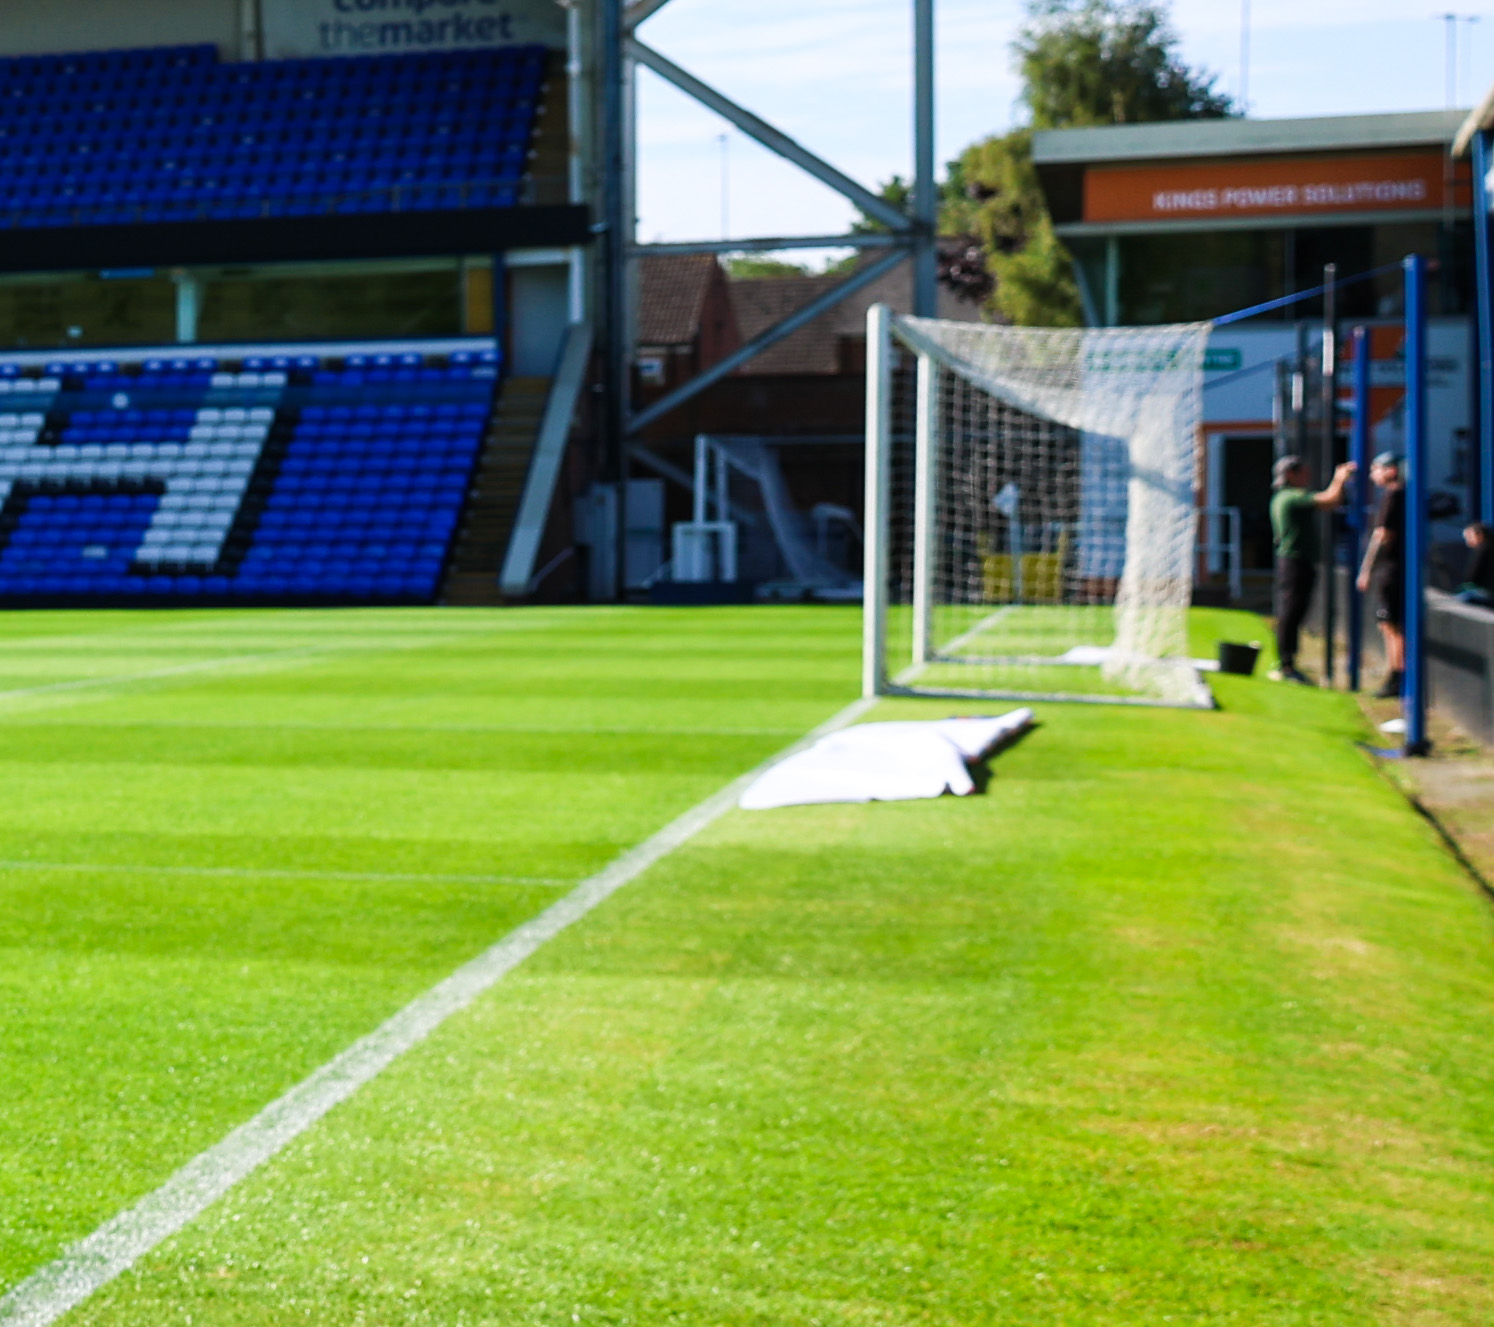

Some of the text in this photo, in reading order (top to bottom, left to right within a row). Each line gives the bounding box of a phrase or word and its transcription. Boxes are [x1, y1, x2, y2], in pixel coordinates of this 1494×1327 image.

[319, 13, 514, 50] themarket
[1153, 180, 1427, 211] KINGS POWER SOLUTIONS
